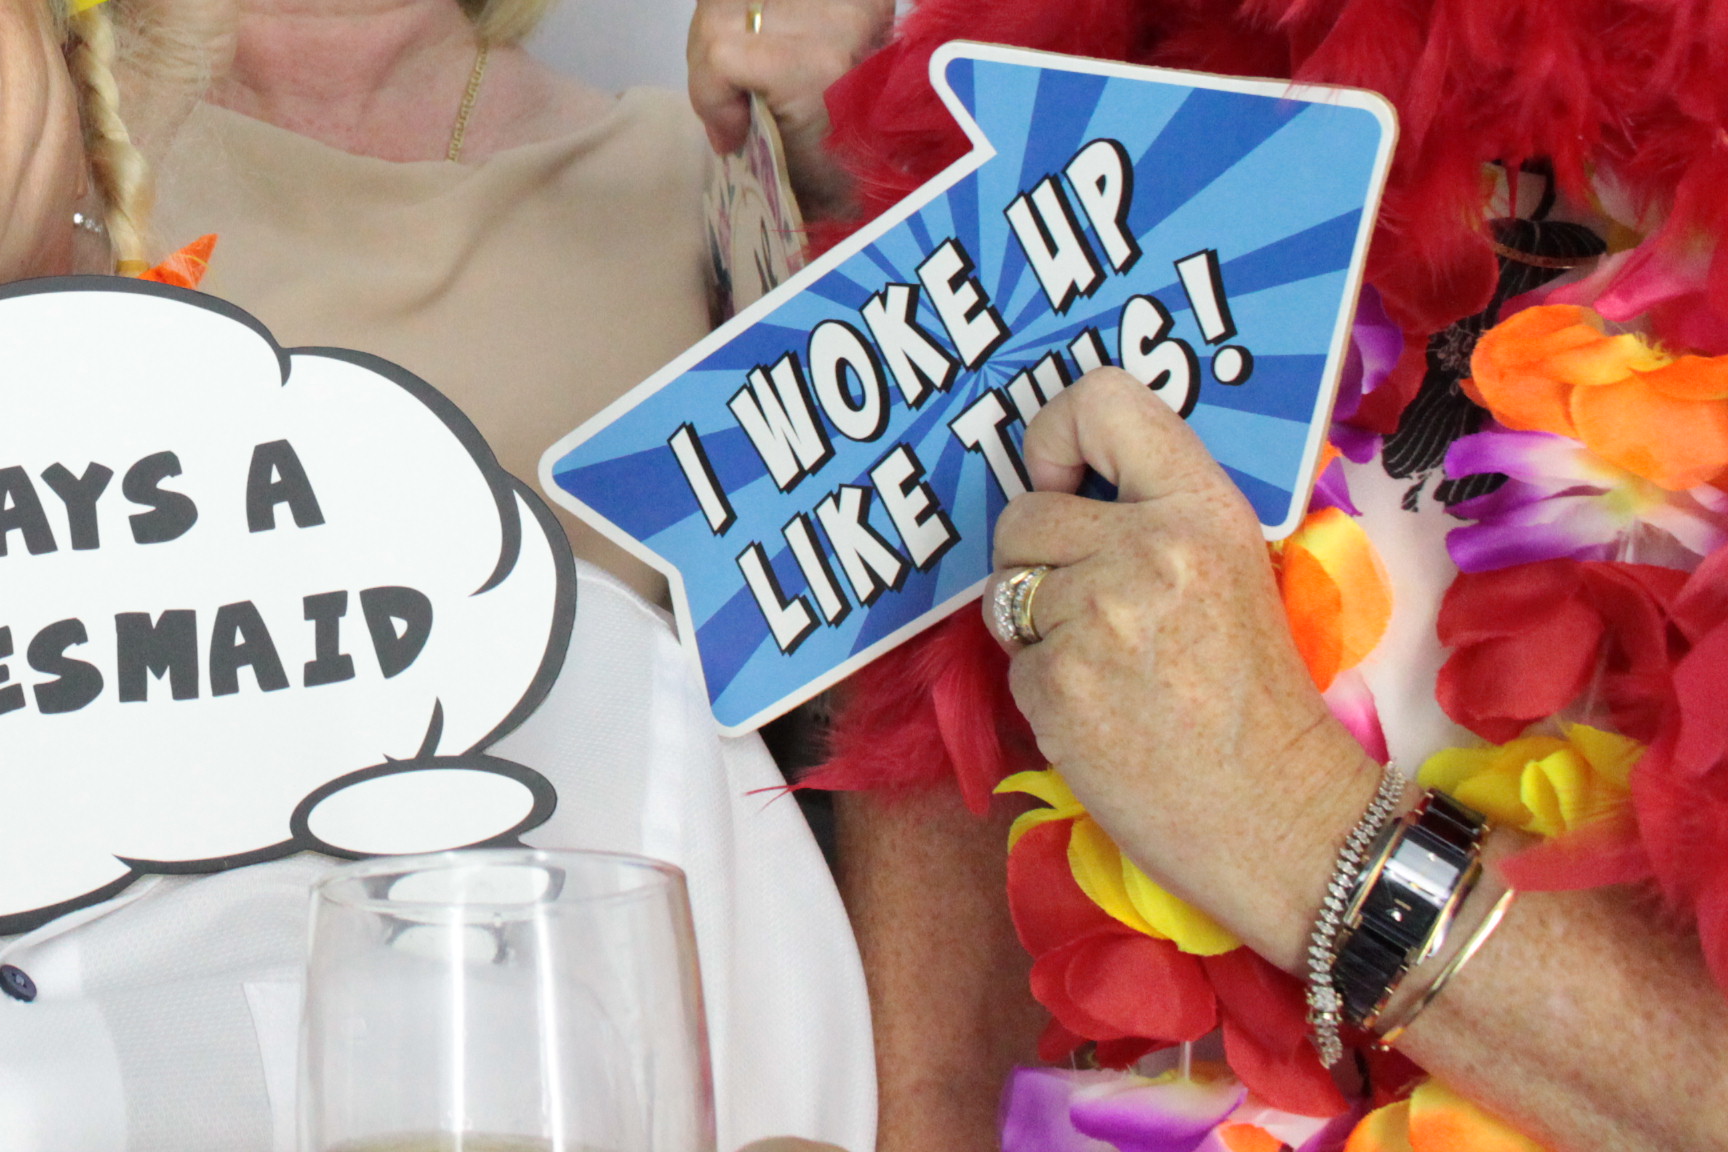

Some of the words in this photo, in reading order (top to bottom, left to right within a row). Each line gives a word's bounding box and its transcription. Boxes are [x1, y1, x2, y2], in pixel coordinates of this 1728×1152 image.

[668, 422, 737, 536] I
[728, 237, 1012, 493] WOKE
[1004, 138, 1143, 315] UP
[246, 439, 326, 533] A
[735, 443, 962, 654] LIKE
